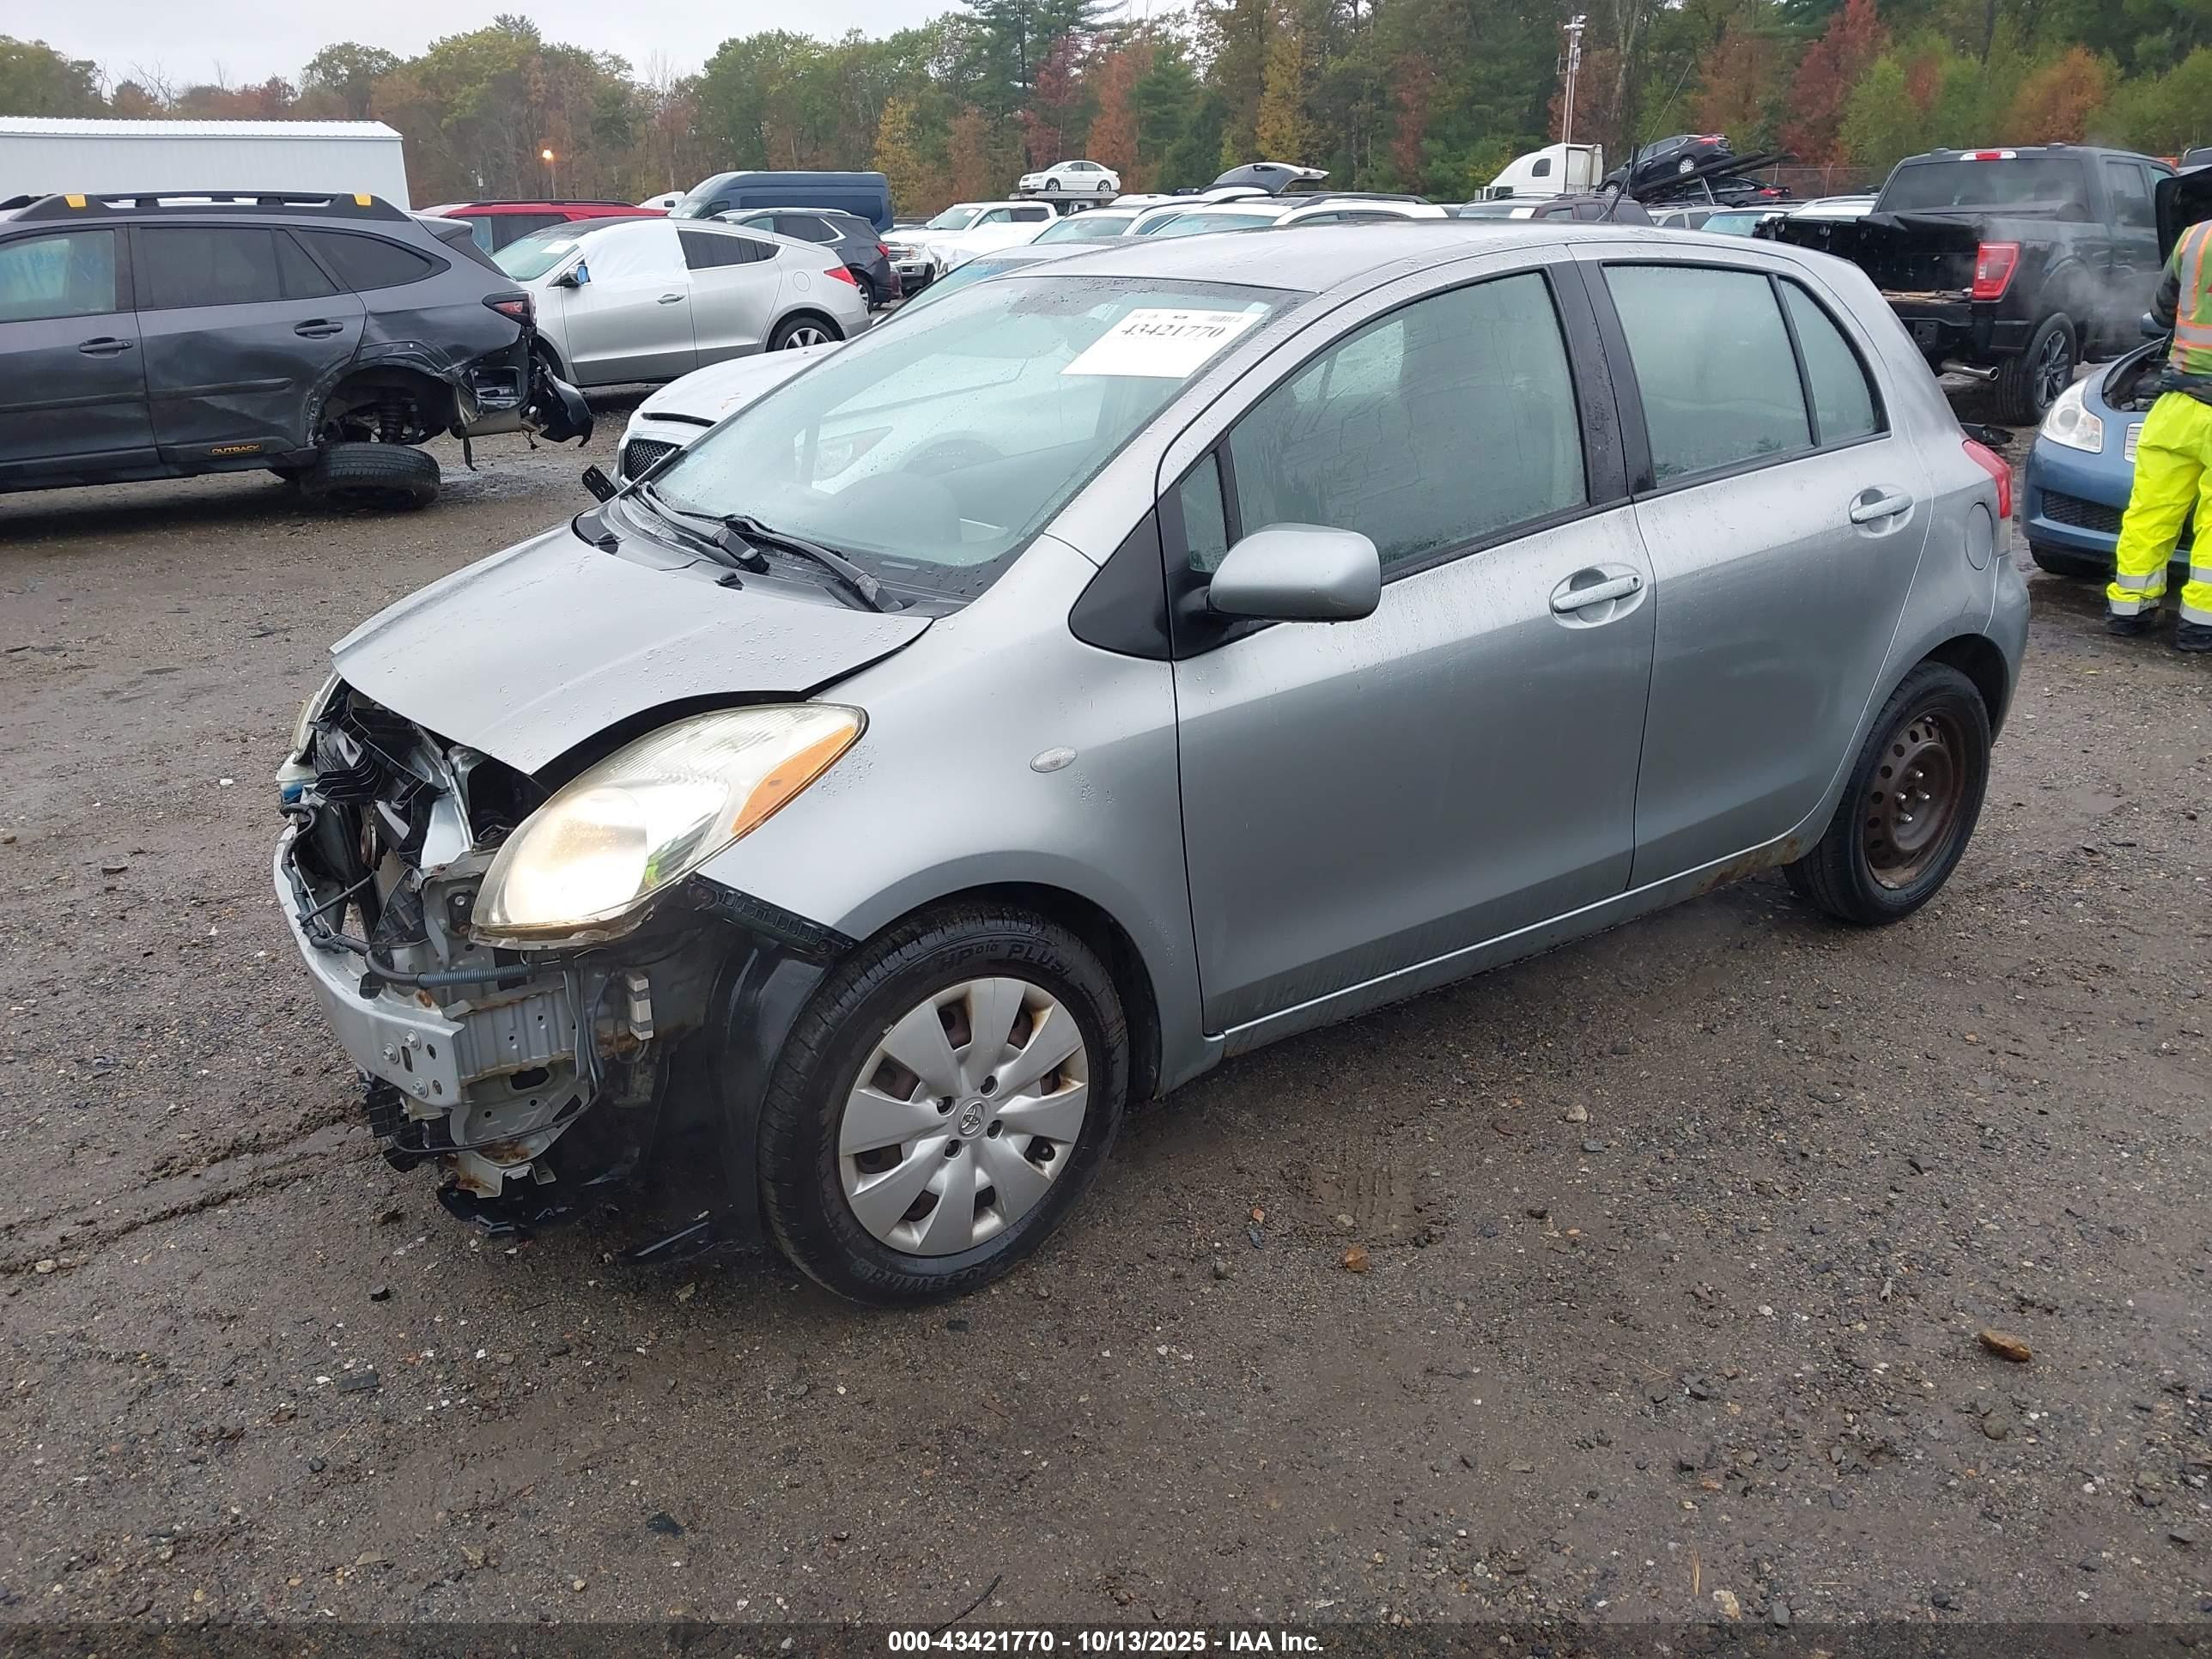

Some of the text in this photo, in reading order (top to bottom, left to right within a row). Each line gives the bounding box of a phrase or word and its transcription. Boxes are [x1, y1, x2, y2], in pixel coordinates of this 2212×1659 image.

[1121, 324, 1226, 337] 43421770
[212, 444, 260, 453] OUTBACK
[1006, 943, 1073, 976] PLUS
